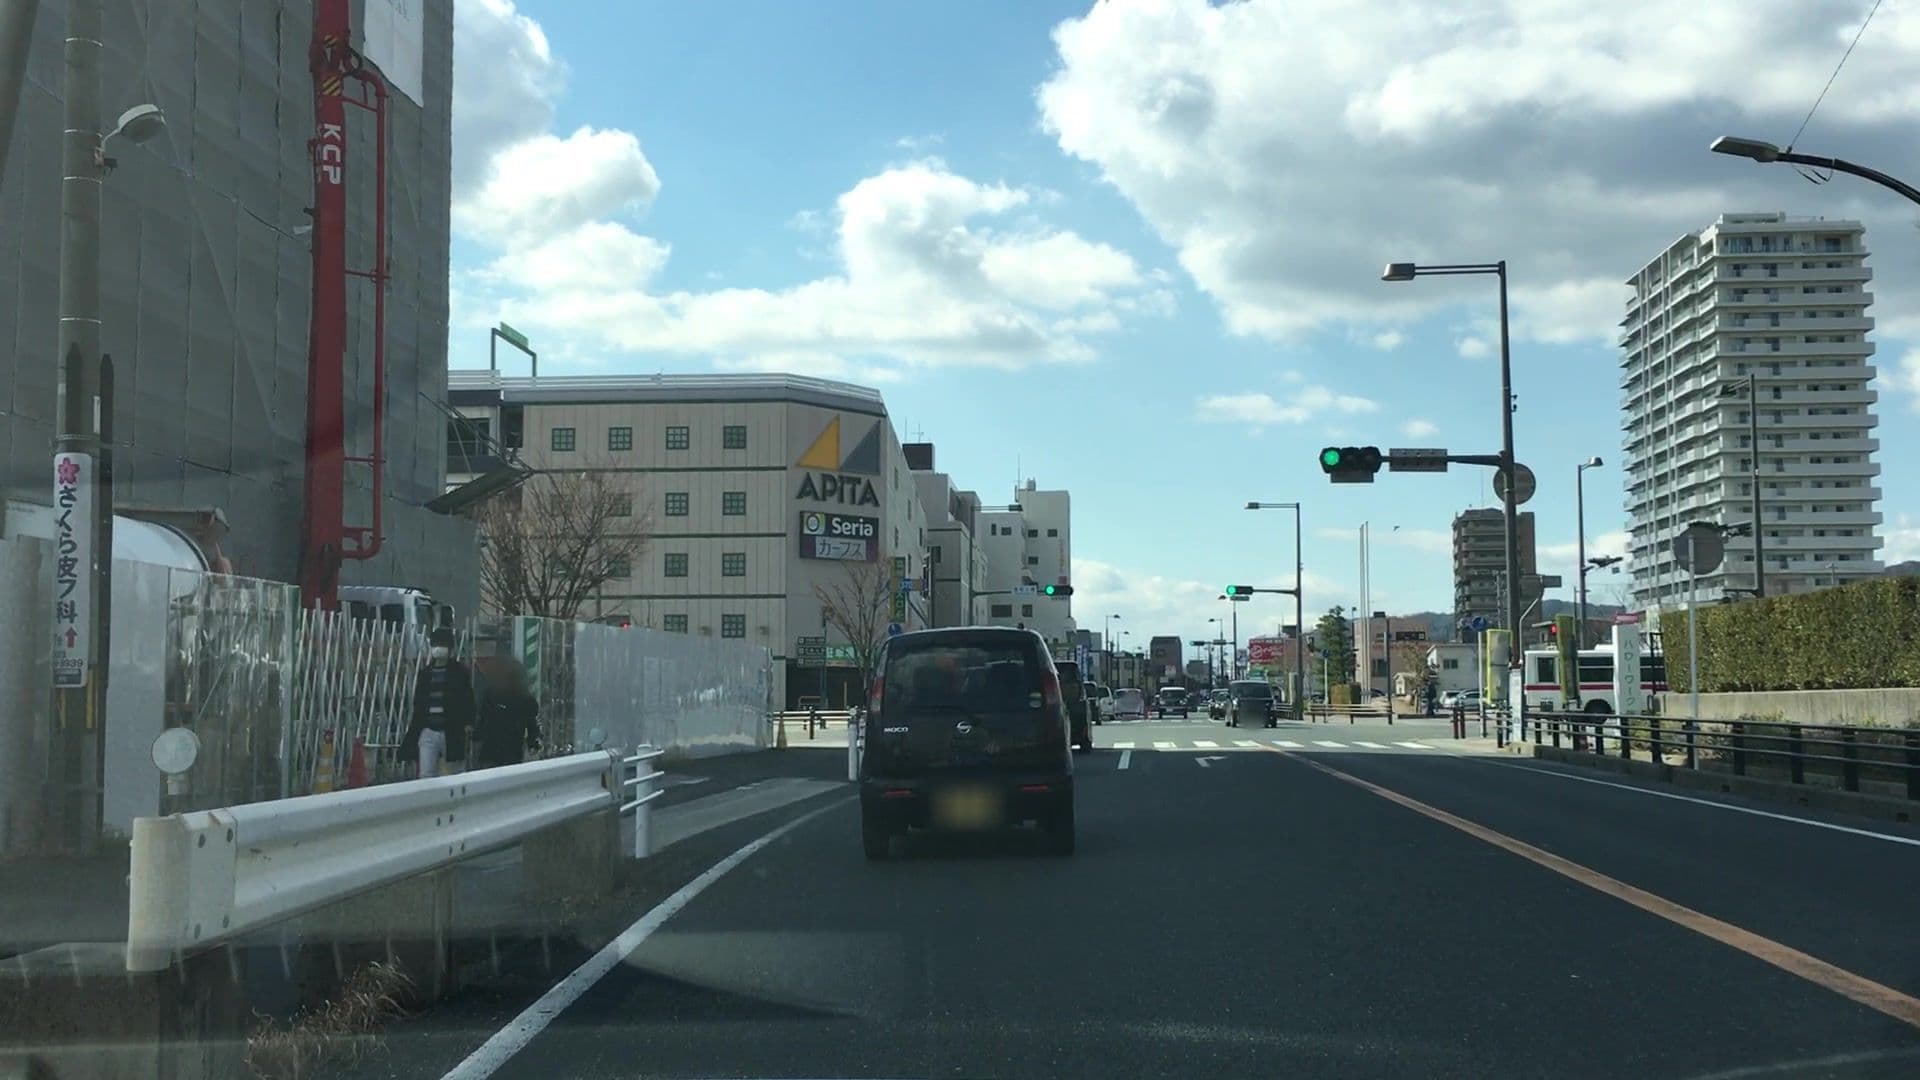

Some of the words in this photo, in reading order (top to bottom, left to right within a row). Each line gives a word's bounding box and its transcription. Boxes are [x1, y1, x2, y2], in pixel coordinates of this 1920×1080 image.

[323, 123, 341, 184] KCP
[796, 472, 880, 507] APITA
[56, 486, 79, 625] さくら皮フ科
[831, 517, 873, 537] Seria
[1624, 640, 1635, 714] ハローワーク
